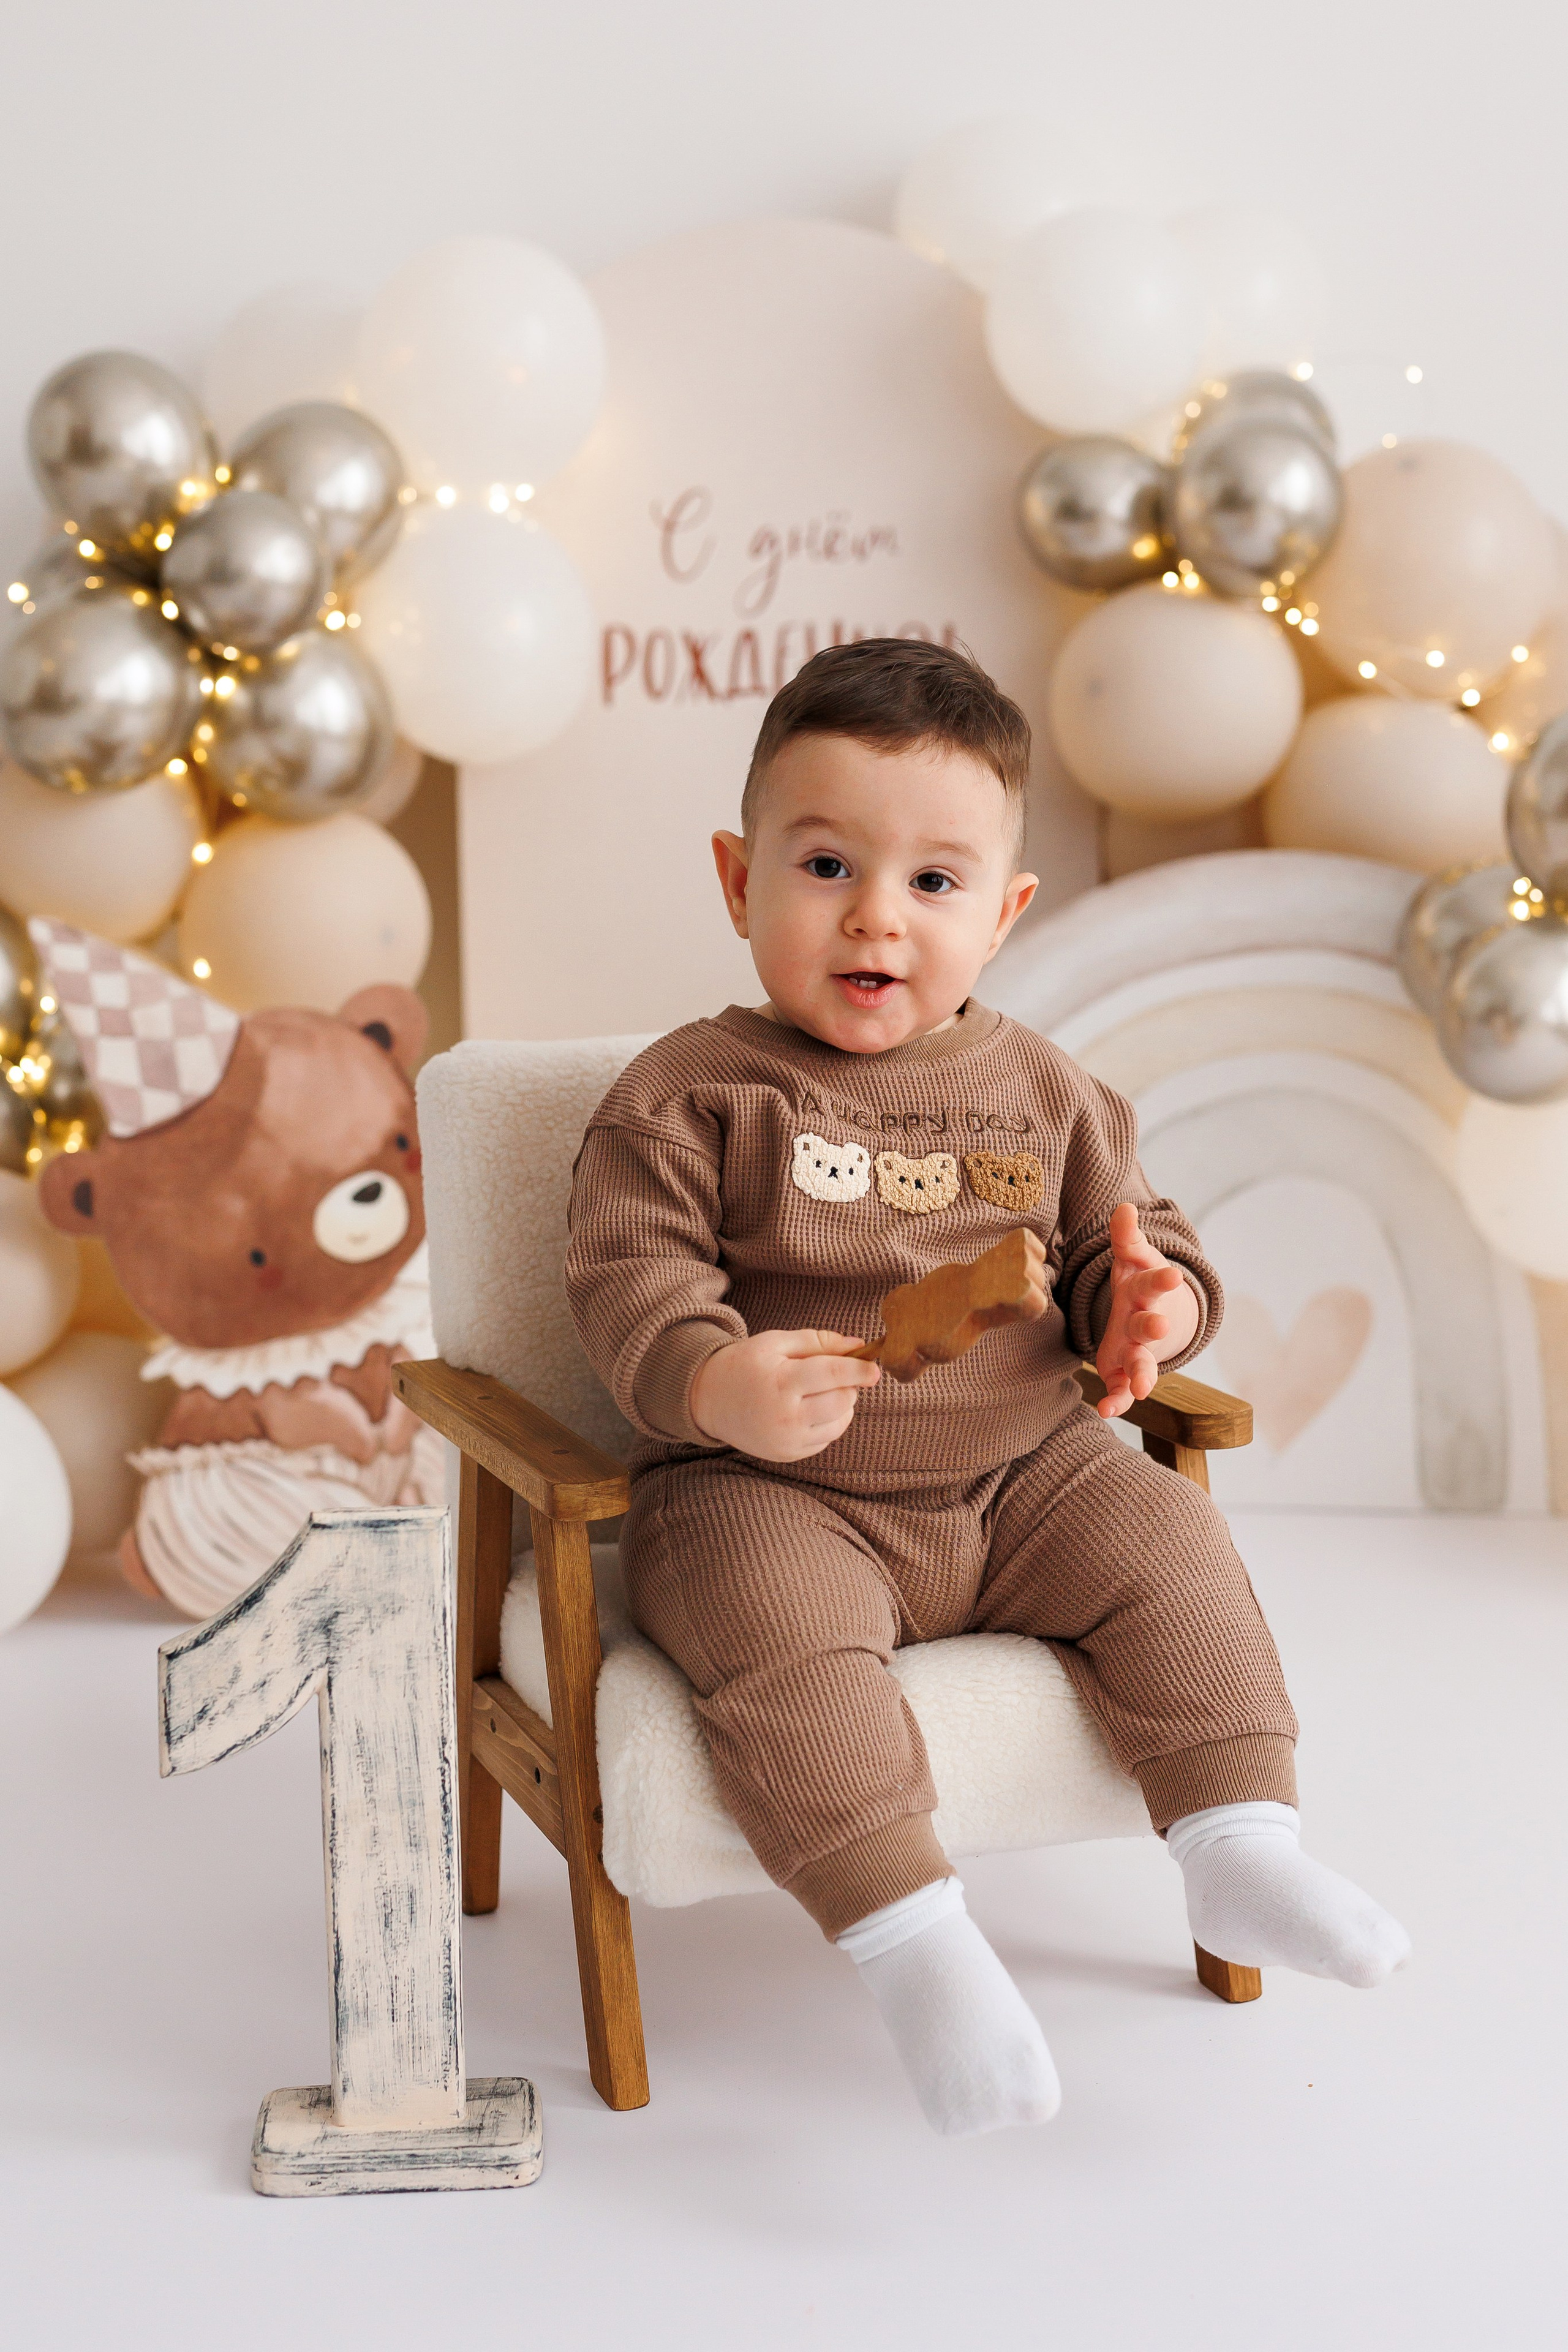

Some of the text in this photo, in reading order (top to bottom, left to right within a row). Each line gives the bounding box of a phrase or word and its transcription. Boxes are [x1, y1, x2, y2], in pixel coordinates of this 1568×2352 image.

[649, 485, 718, 585] С
[600, 619, 958, 707] РОЖДЕ
[801, 1091, 826, 1116] A
[158, 1506, 466, 2129] 1
